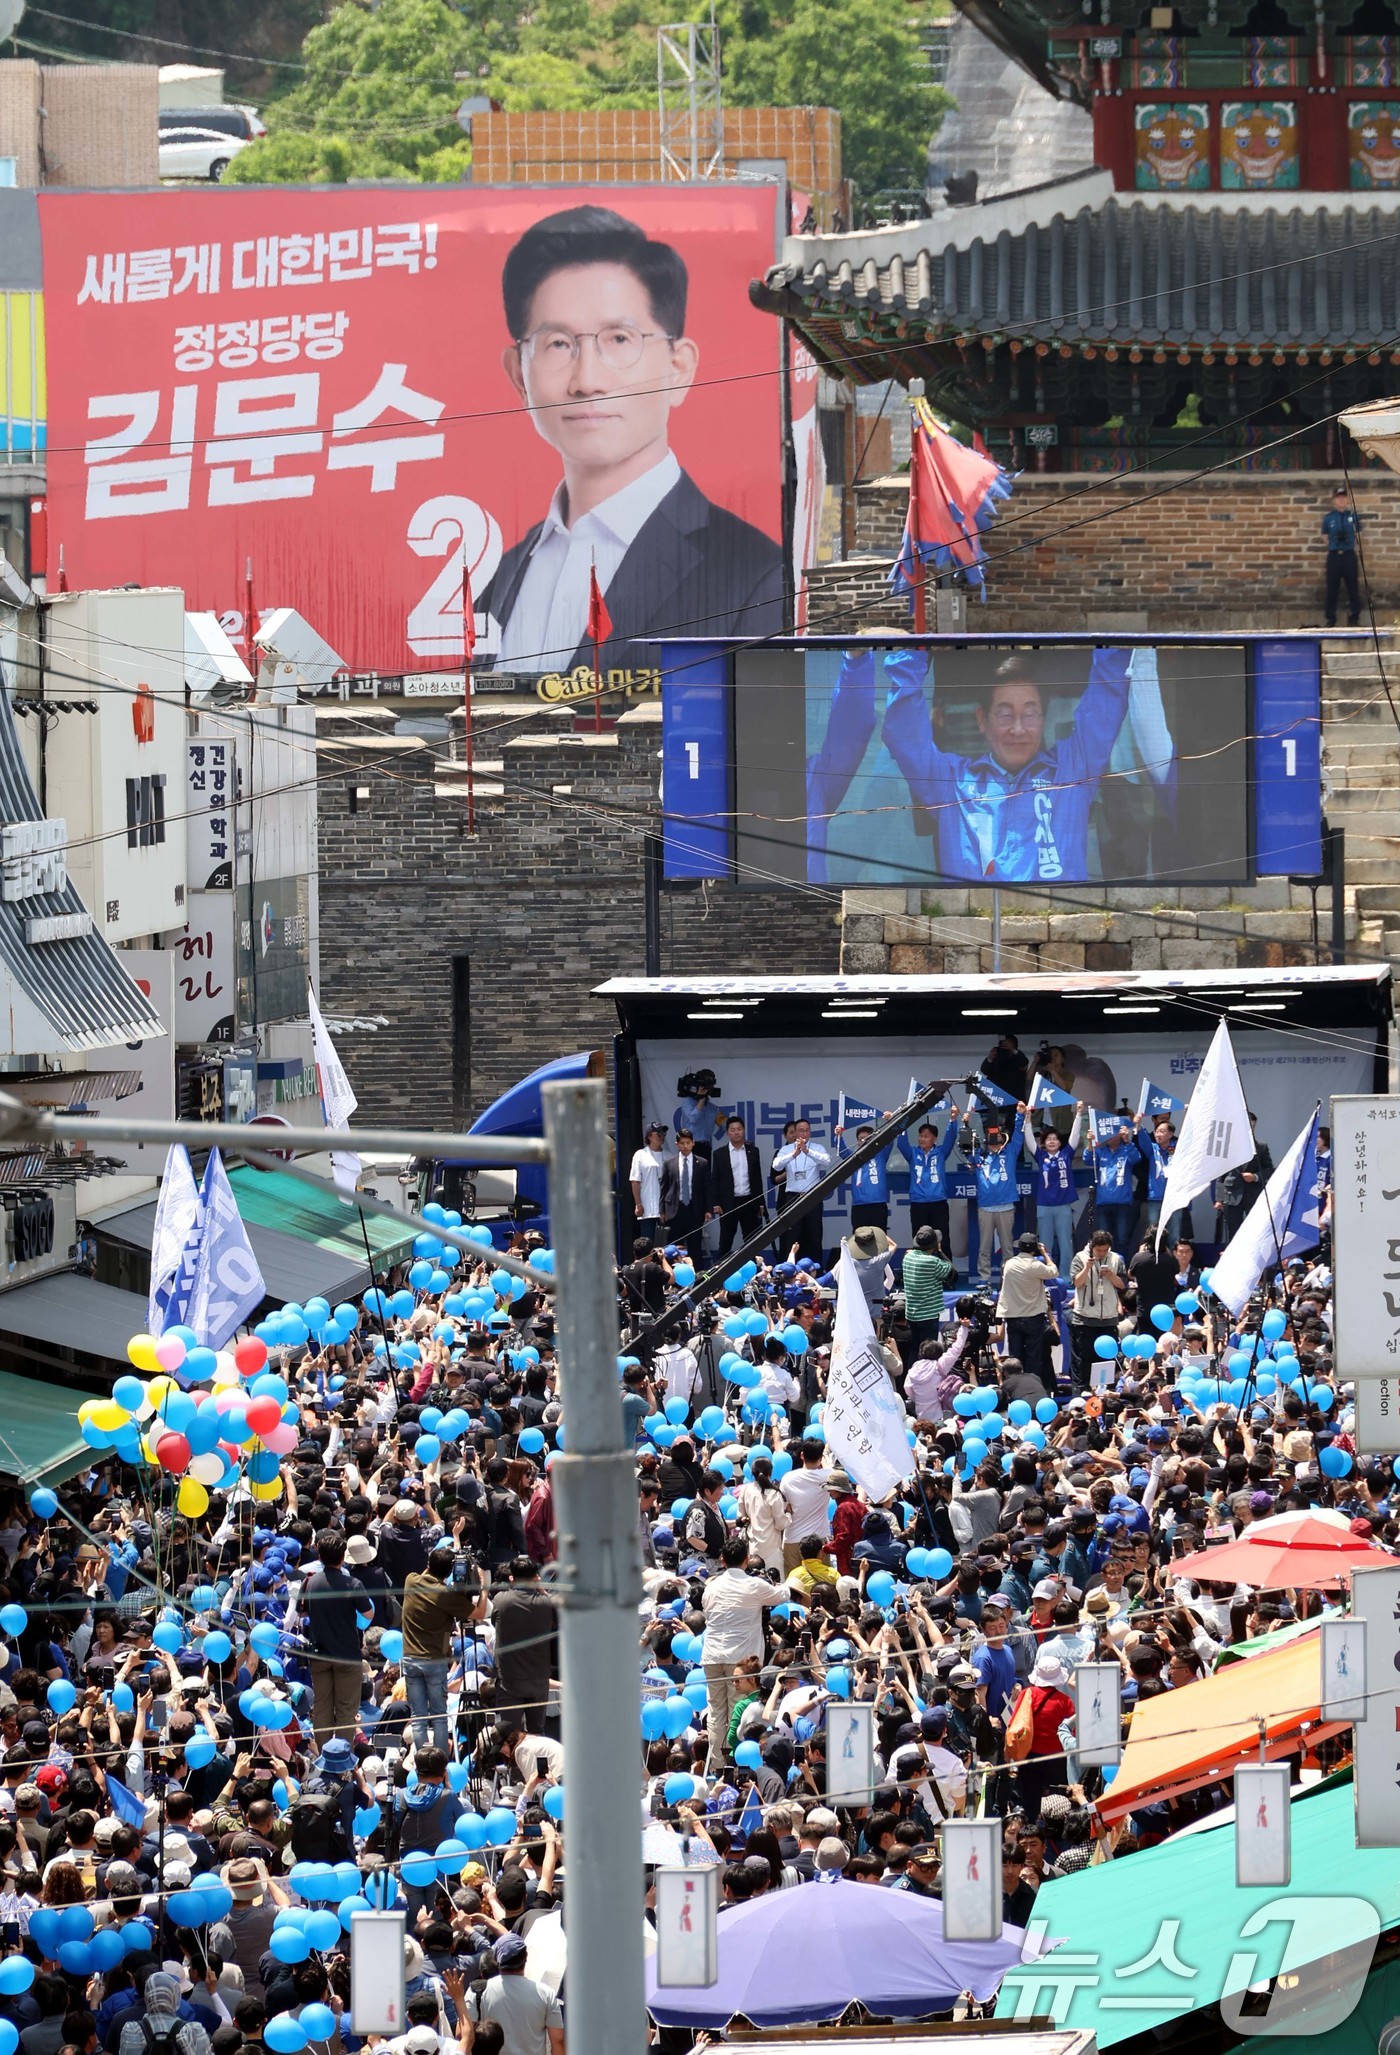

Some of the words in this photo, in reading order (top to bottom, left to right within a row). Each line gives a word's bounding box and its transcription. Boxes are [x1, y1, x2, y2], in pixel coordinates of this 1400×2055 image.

[77, 241, 221, 306] 새롭게
[231, 222, 440, 290] 대한민국!
[173, 310, 349, 372] 정정당당
[84, 362, 446, 521] 김문수
[406, 494, 503, 658] 2
[537, 666, 604, 702] Cafe
[189, 746, 205, 790] 정신
[684, 741, 700, 780] 1
[1281, 739, 1297, 777] 1
[210, 746, 227, 860] 건강의학과
[215, 874, 229, 886] 2F
[216, 1027, 230, 1040] 1F
[1170, 1058, 1202, 1074] 민주
[845, 1108, 877, 1119] 내란종식
[1039, 1087, 1056, 1103] K
[1150, 1096, 1172, 1110] 수원
[1367, 1109, 1400, 1121] 즉석도
[956, 1185, 978, 1196] 지금
[1354, 1131, 1368, 1213] 안녕하세요!
[20, 1205, 54, 1261] SOGO
